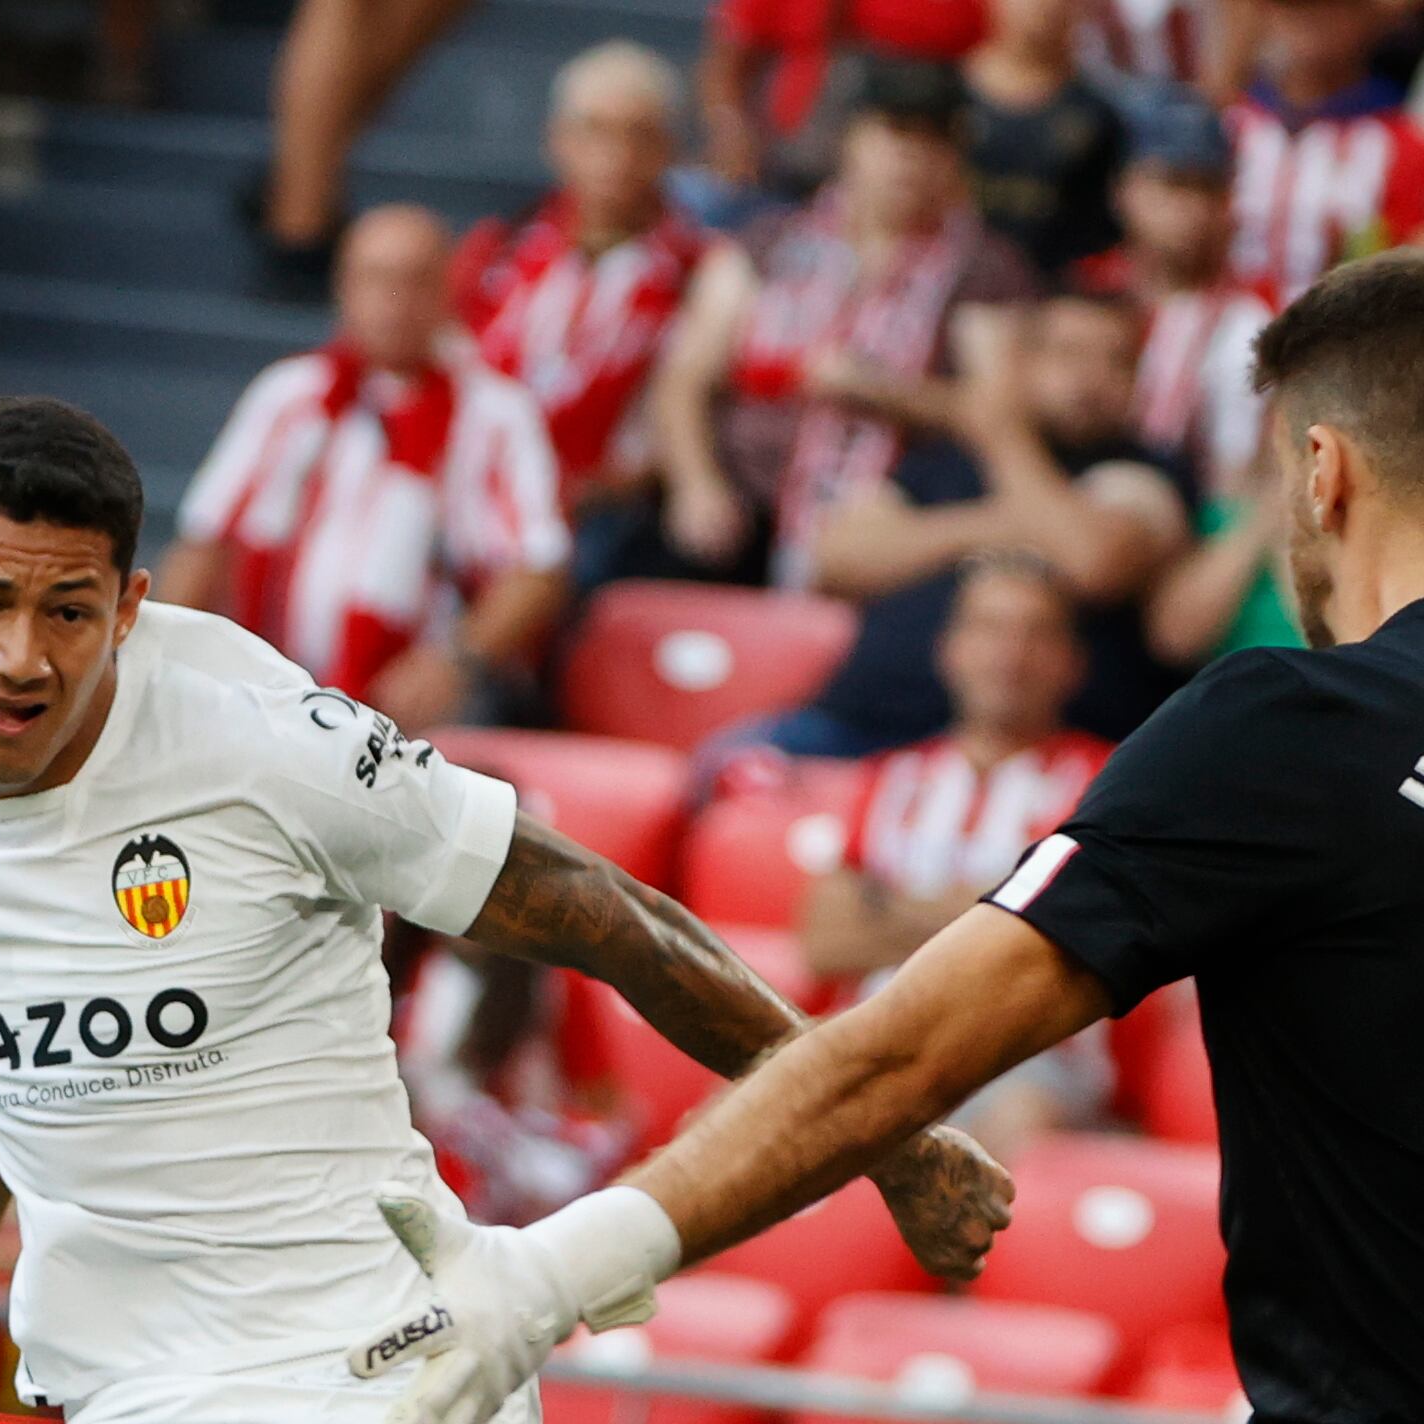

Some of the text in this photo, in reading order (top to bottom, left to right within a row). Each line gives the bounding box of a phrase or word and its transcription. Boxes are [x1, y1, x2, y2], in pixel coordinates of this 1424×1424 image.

[25, 1076, 121, 1106] Conduce.
[126, 1049, 230, 1088] Disfruta.
[366, 1304, 454, 1370] reusch
